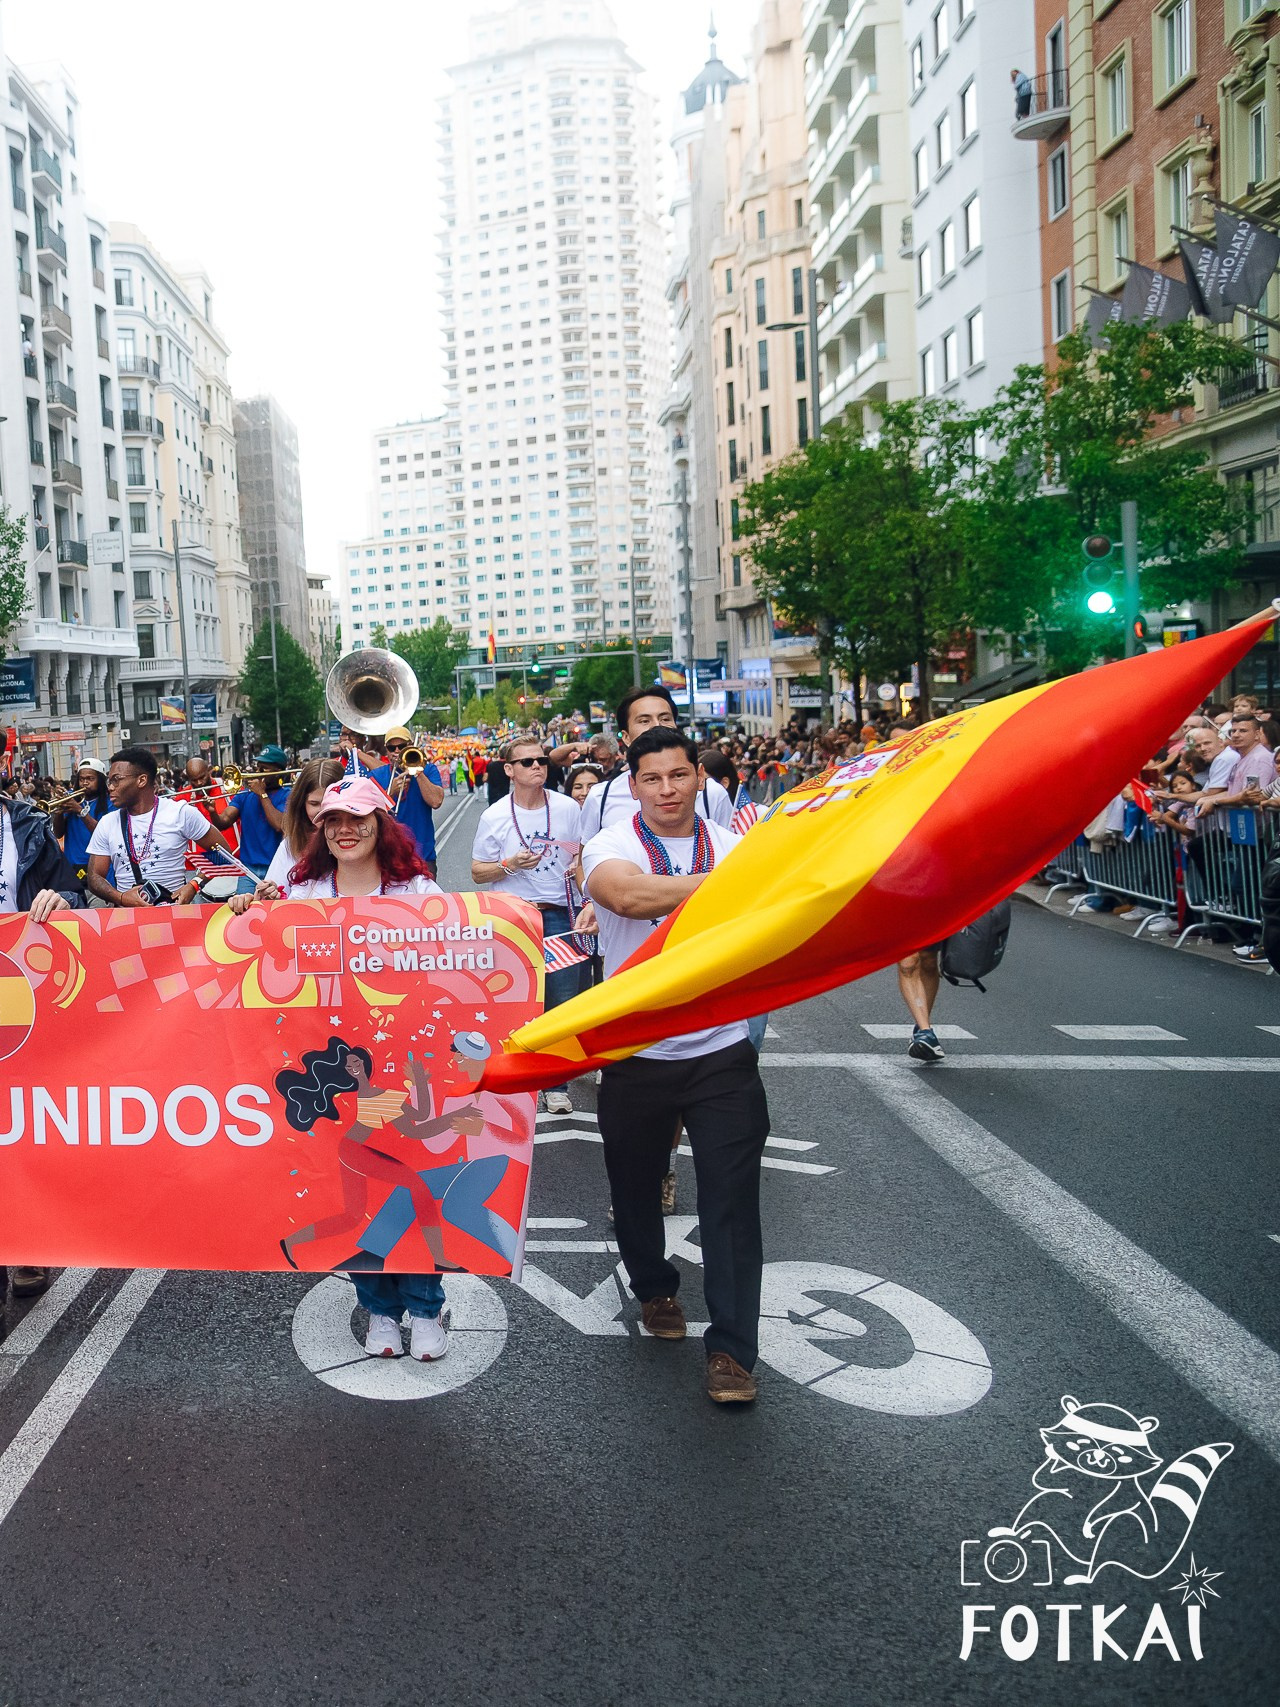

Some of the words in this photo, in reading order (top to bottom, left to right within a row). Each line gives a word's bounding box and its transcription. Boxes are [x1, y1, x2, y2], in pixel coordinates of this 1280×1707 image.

[347, 919, 494, 945] Comunidad
[349, 951, 384, 973] de
[393, 947, 495, 972] Madrid
